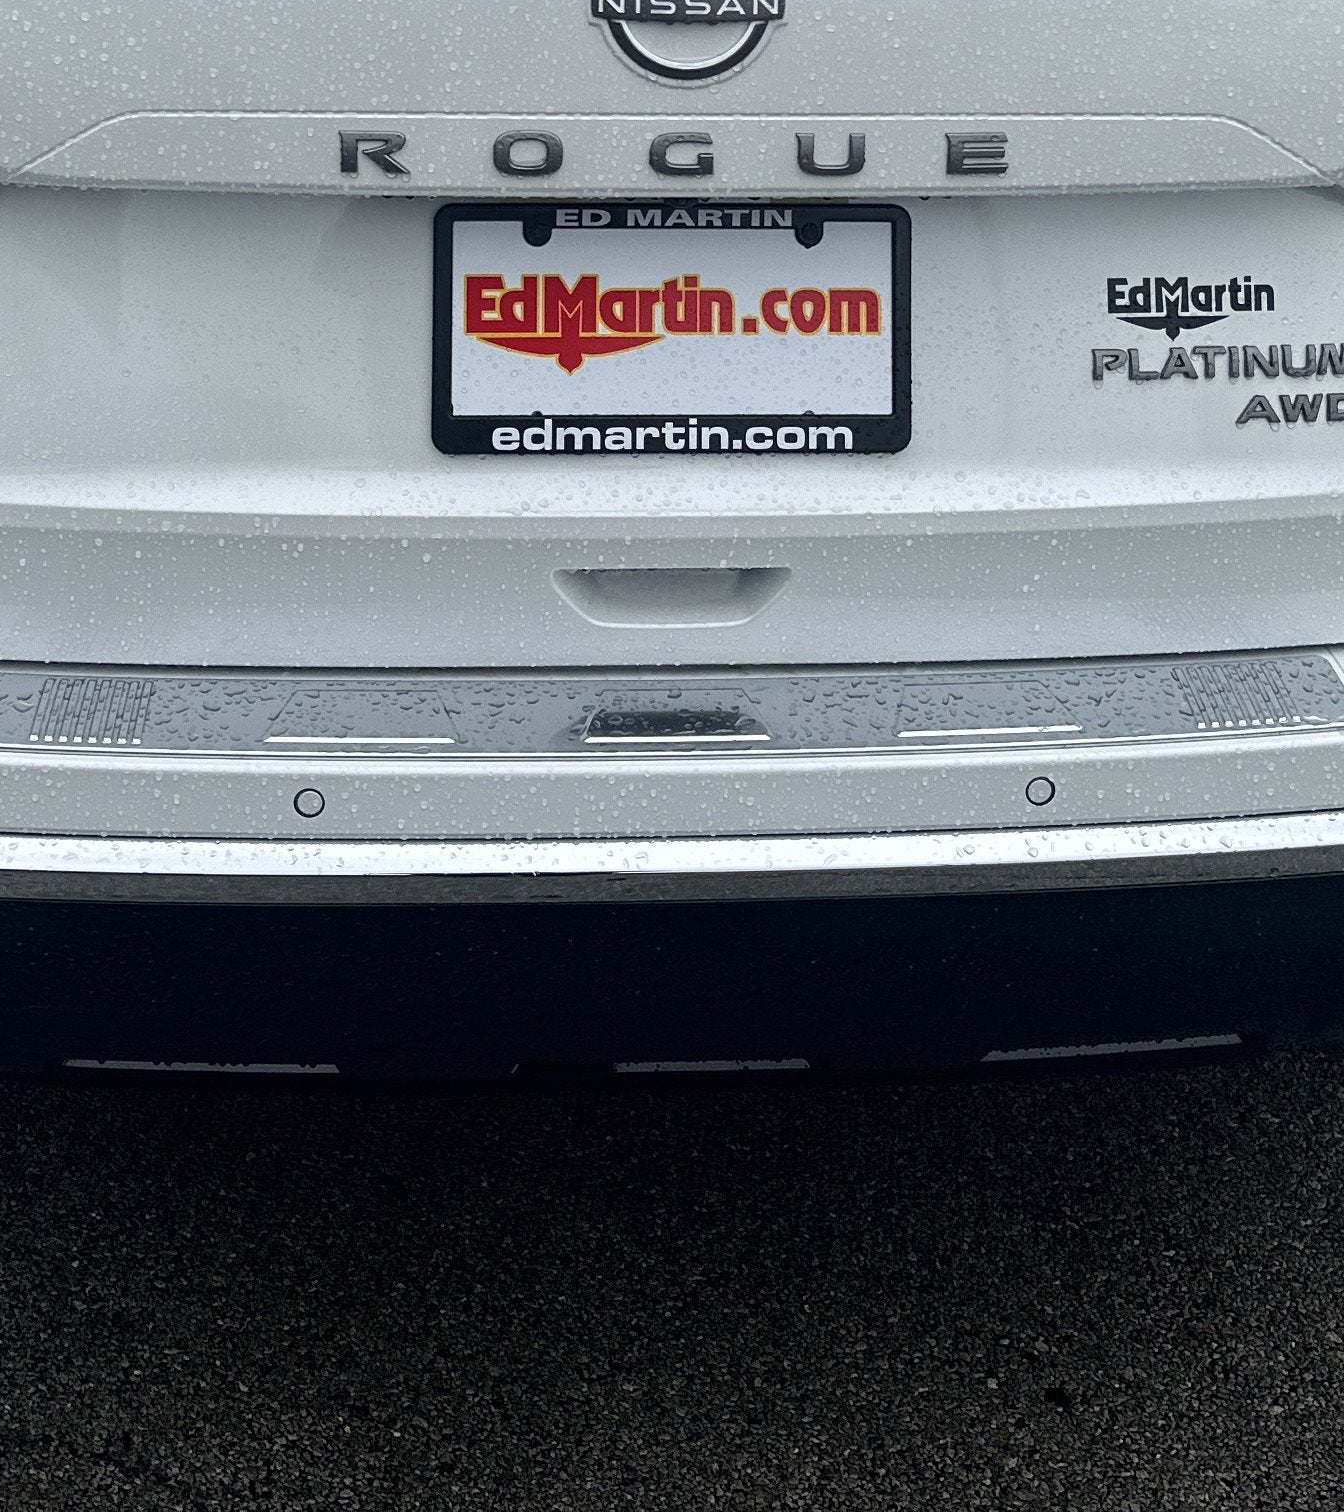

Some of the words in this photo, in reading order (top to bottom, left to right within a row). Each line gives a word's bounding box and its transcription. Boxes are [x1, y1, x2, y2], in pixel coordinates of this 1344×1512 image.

[338, 129, 1009, 177] ROGUE
[556, 209, 613, 228] ED
[626, 209, 794, 228] MARTIN
[463, 274, 882, 338] EdMartin.com
[1106, 275, 1276, 314] EdMartin
[491, 418, 854, 452] edmartin.com
